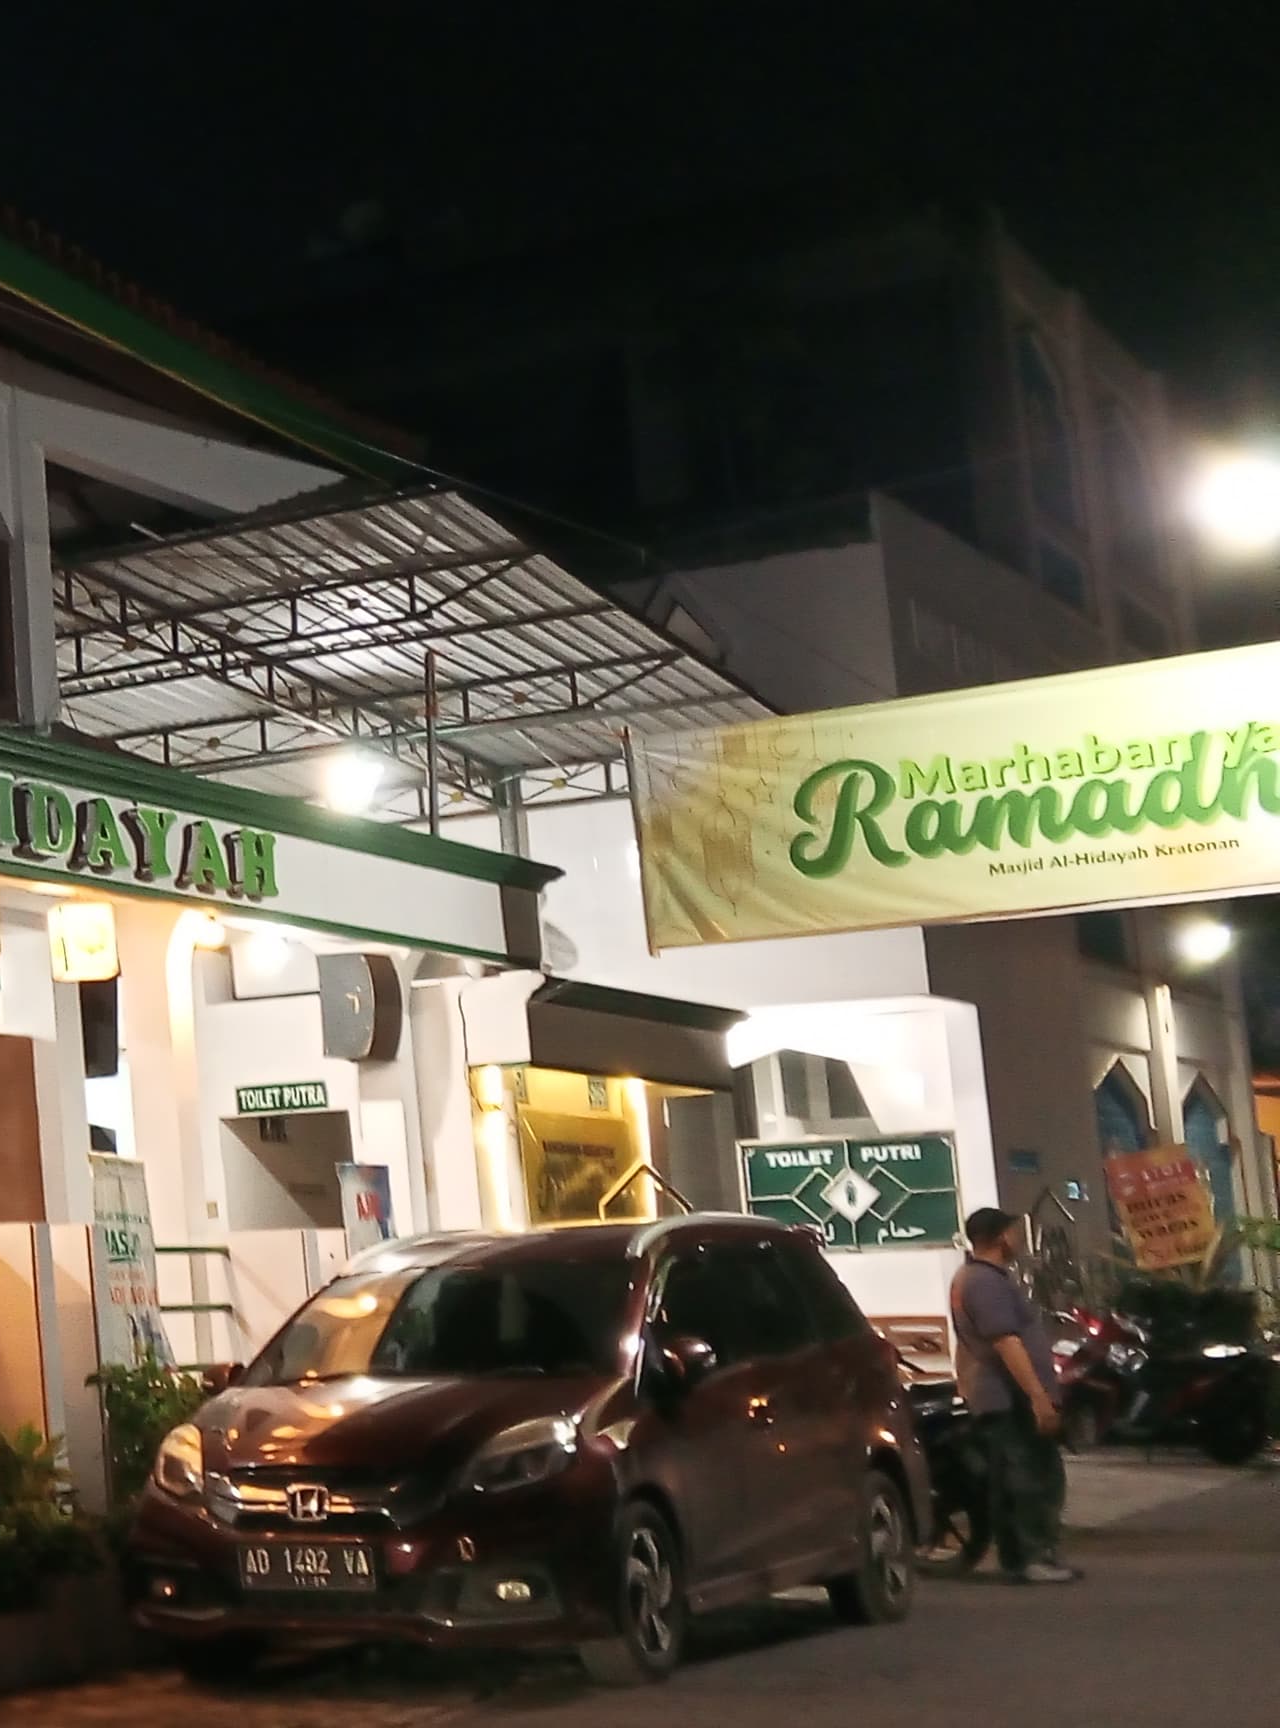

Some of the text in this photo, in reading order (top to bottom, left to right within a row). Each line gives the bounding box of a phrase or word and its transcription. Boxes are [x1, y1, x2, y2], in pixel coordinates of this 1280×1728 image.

[989, 838, 1240, 877] Masjid Al-Hidayah Kratonan
[240, 1084, 326, 1110] TOILET PUTRA
[765, 1144, 922, 1168] TOILET PUTRI
[246, 1548, 270, 1575] AD
[343, 1549, 369, 1576] VA
